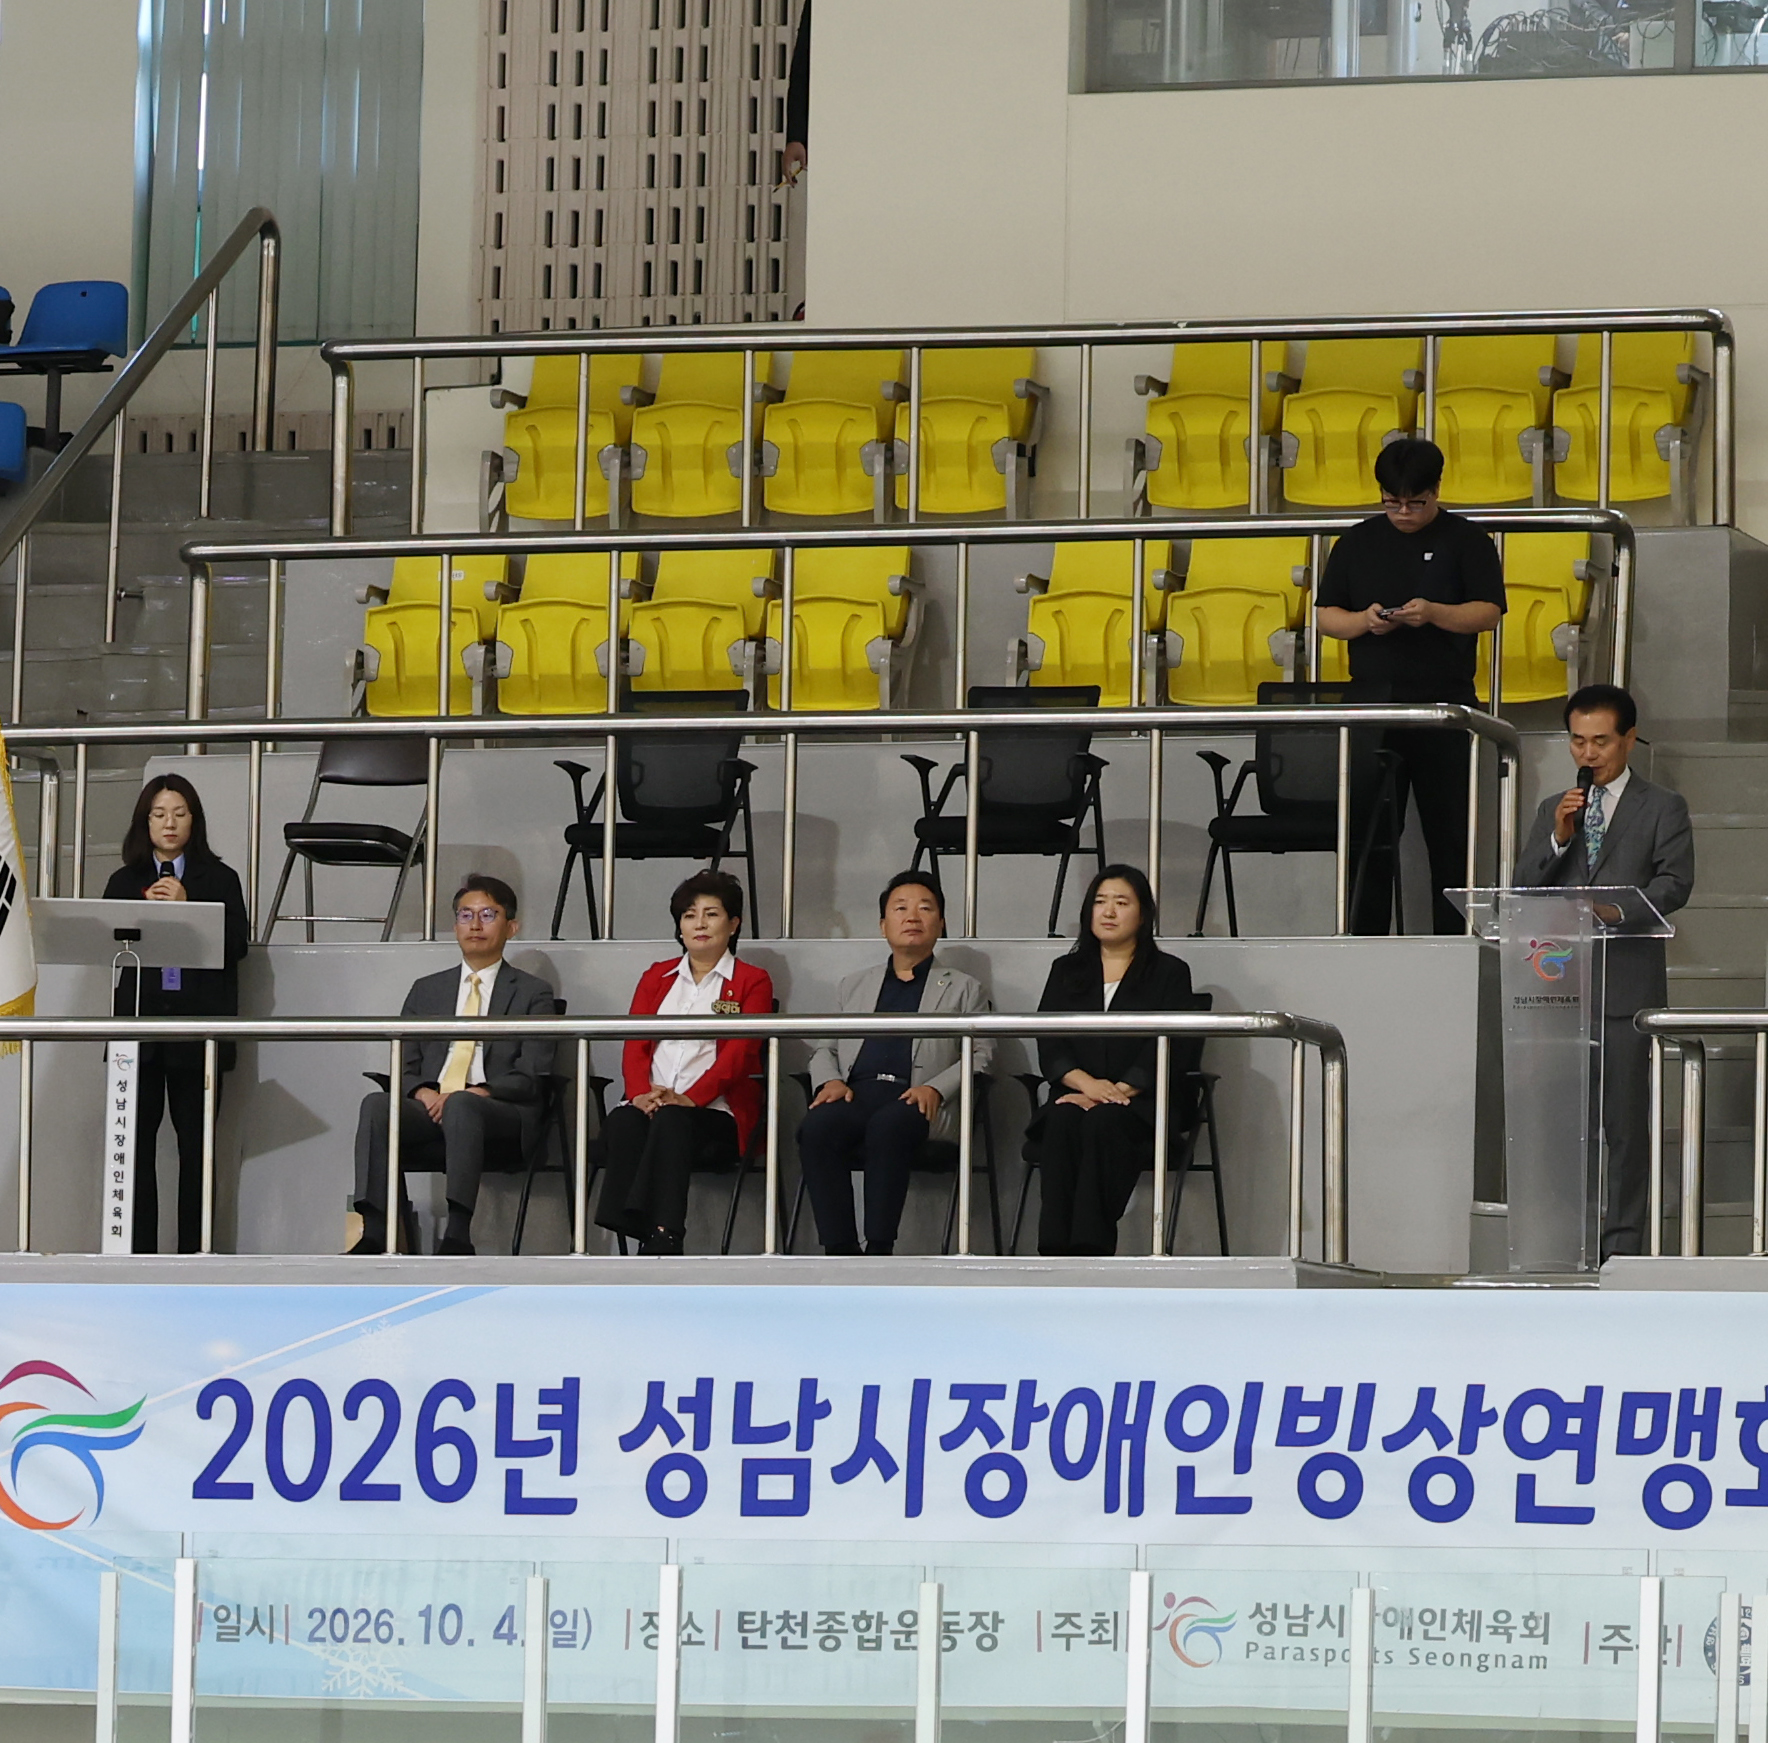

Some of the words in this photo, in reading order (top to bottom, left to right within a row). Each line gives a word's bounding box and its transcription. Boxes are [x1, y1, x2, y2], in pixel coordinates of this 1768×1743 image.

[110, 1079, 129, 1238] 성남시장애인체육회
[192, 1377, 581, 1516] 2026년
[307, 1605, 406, 1647] 2026.
[418, 1602, 475, 1648] 10.
[1247, 1601, 1551, 1646] 성남시애인체육회
[1408, 1646, 1549, 1673] Seongnam
